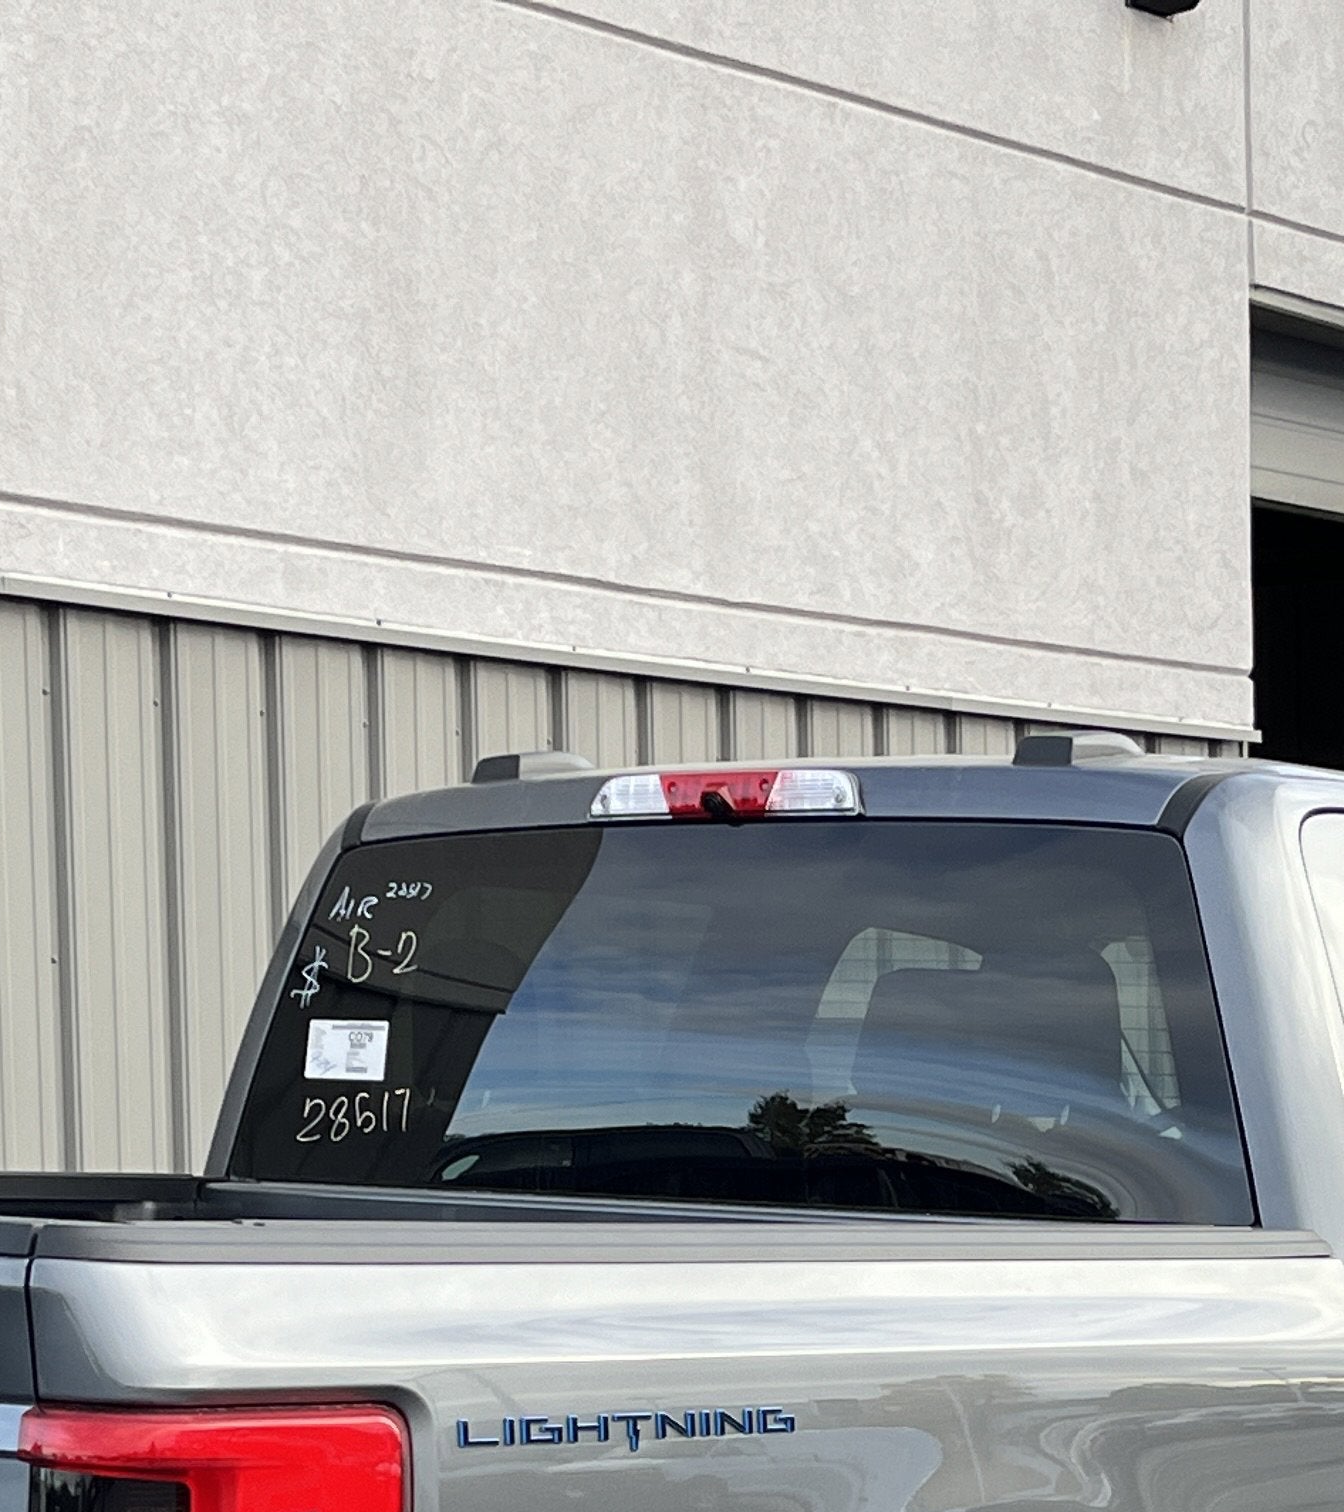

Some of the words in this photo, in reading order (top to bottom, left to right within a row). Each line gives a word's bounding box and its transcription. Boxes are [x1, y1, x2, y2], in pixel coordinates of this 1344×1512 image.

[328, 886, 379, 922] AIR
[347, 924, 418, 983] B-2
[456, 1406, 796, 1452] LIGHTNING
